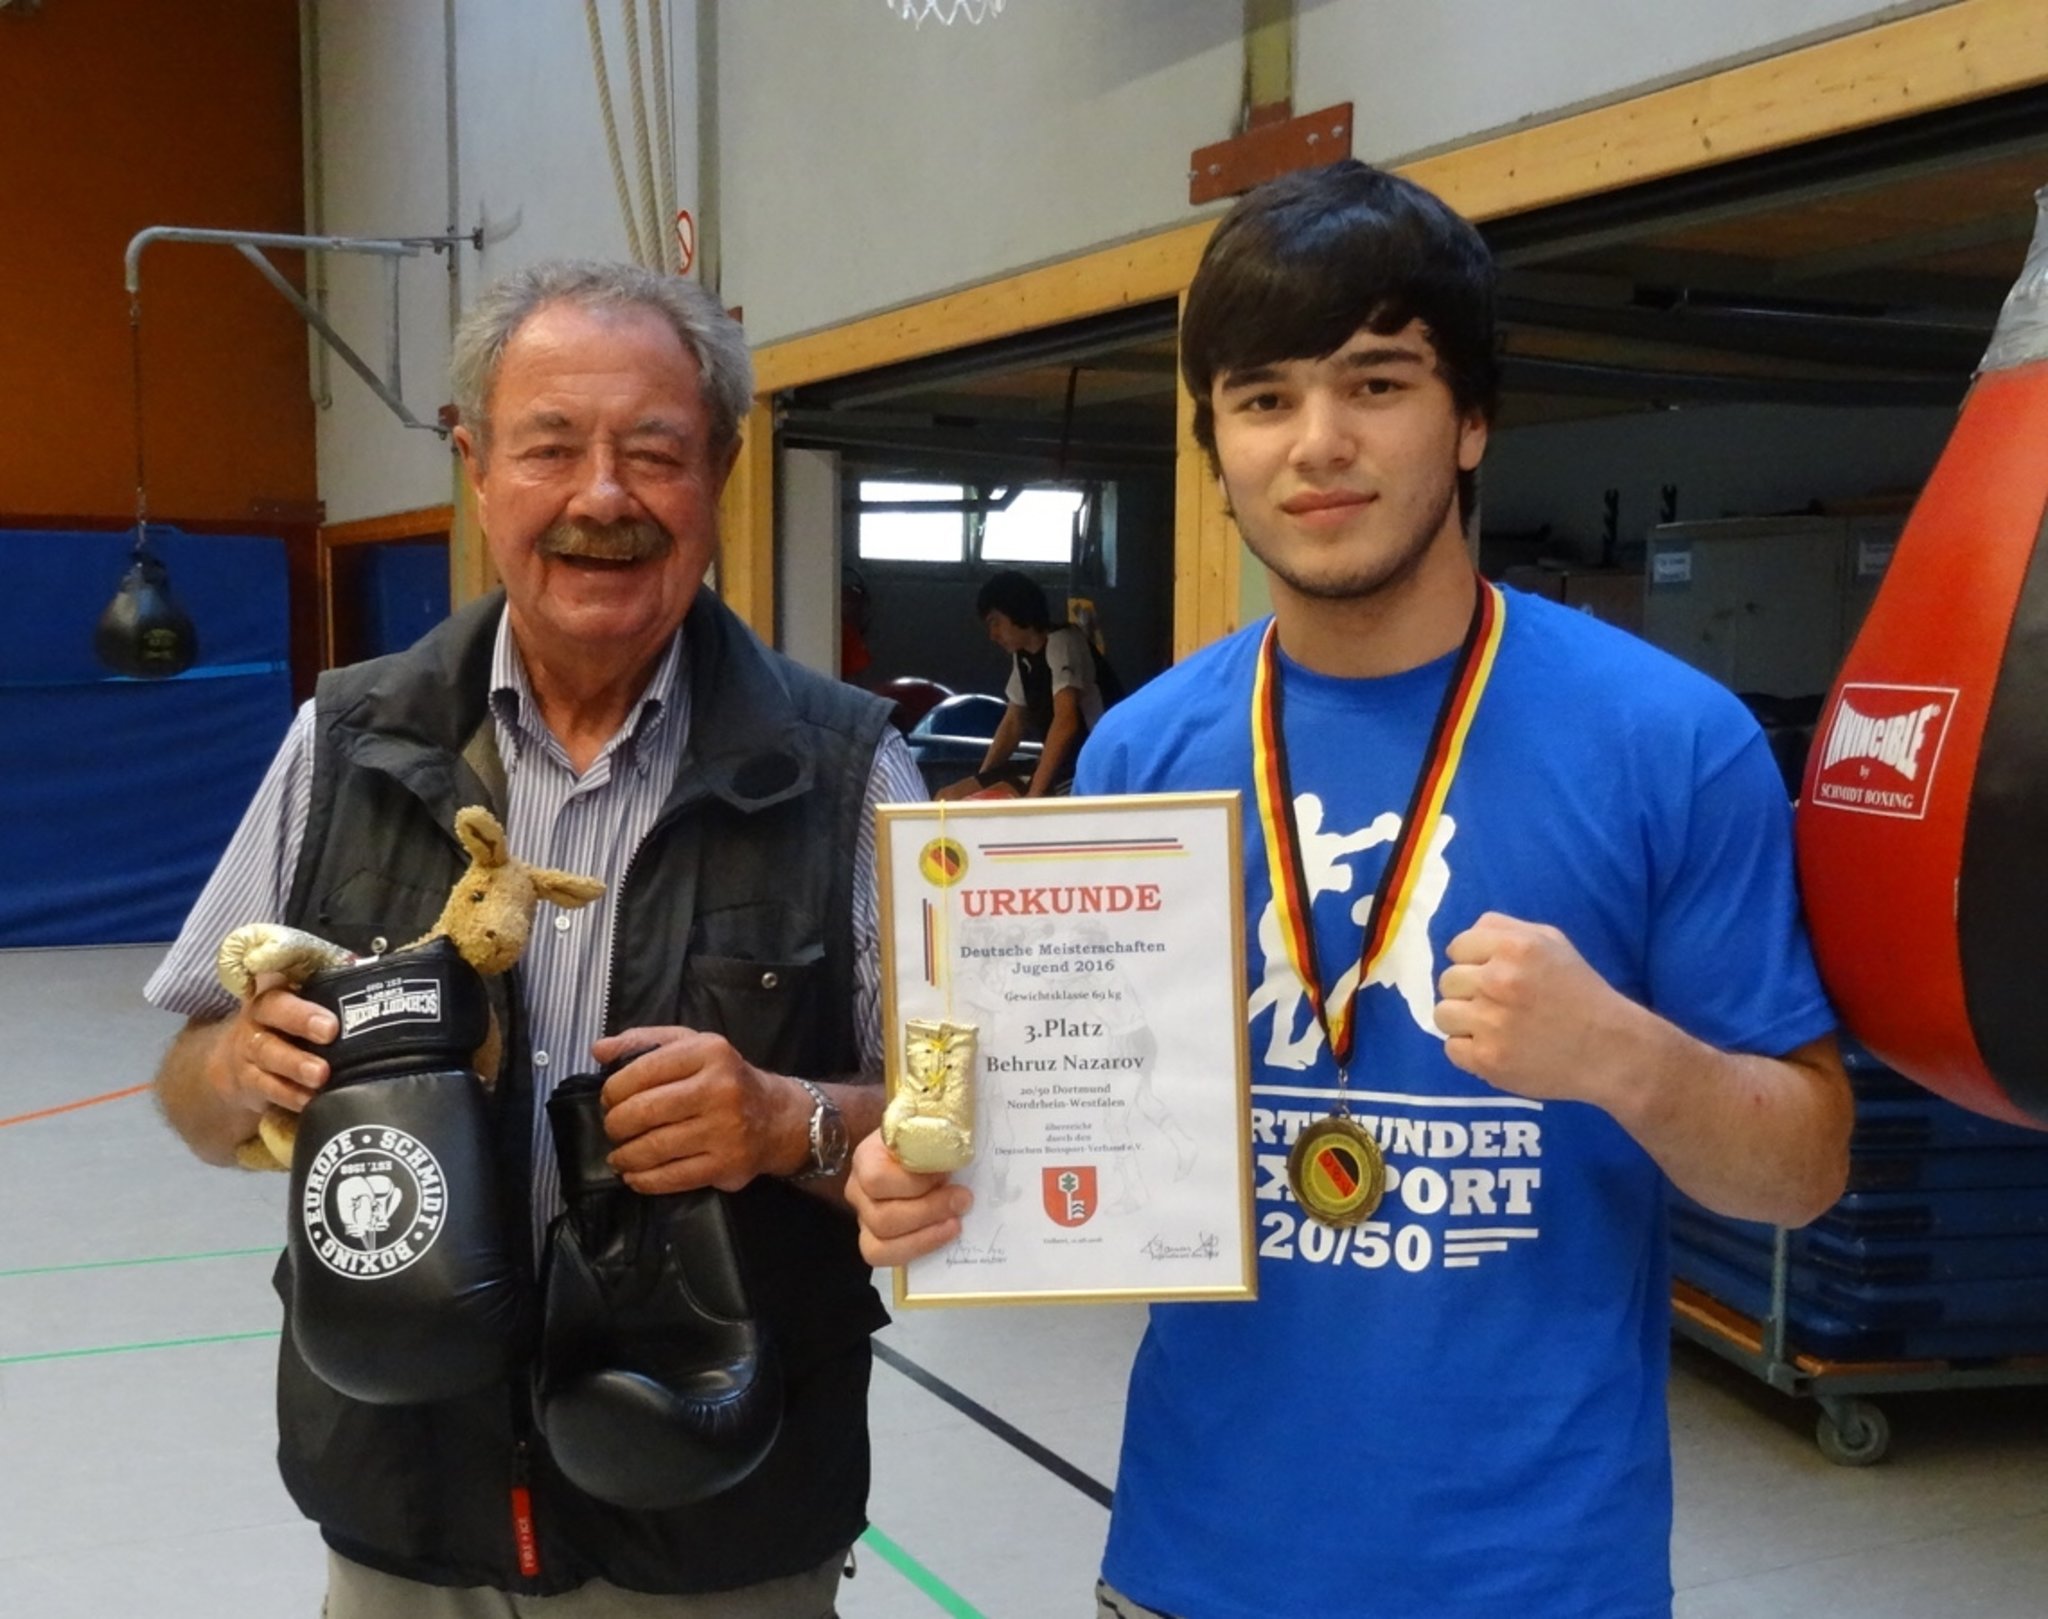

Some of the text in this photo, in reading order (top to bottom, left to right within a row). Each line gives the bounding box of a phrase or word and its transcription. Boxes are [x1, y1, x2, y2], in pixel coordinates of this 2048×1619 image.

[1821, 782, 1915, 810] SCHMIDT BOXING
[960, 884, 1162, 917] URKUNDE
[960, 941, 1166, 959] Deutsche Meisterschaften
[1011, 959, 1115, 977] Jugend 2016
[1004, 989, 1089, 1002] Gewichtsklasse
[1107, 989, 1122, 1001] kg
[1024, 1018, 1103, 1044] 3.Platz
[986, 1054, 1145, 1072] Behruz Nazarov
[1052, 1083, 1111, 1095] Dortmund
[1007, 1097, 1125, 1110] Nordrhein-Westfalen
[1251, 1107, 1542, 1158] RTUNDER
[307, 1130, 443, 1231] EUROPE SCHMIDT
[1259, 1211, 1432, 1272] 20/50
[320, 1239, 416, 1274] BOXING
